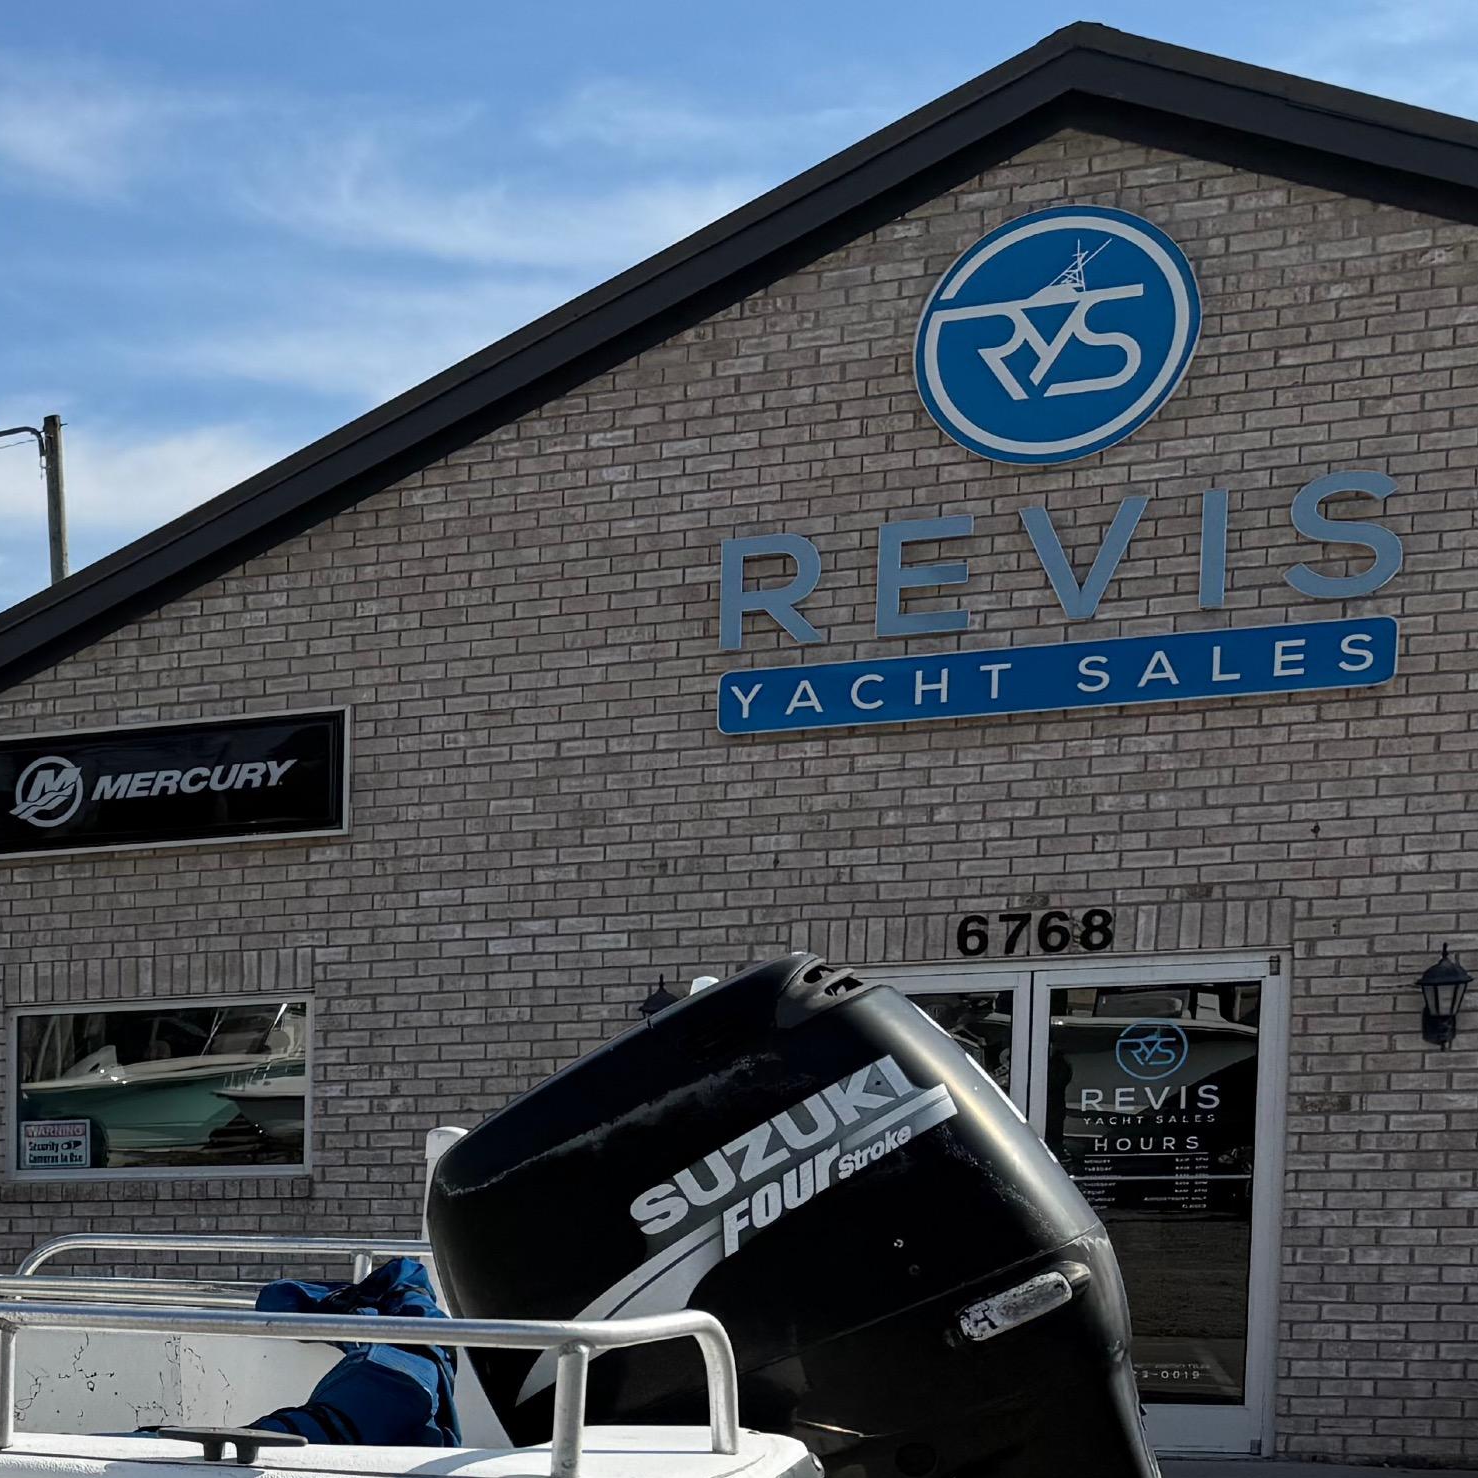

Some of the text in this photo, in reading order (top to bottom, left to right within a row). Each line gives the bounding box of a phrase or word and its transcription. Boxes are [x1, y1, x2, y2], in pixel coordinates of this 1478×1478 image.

[717, 470, 1404, 651] REVIS
[730, 633, 1376, 719] YACHT SALES
[91, 759, 298, 801] MERCURY
[956, 909, 1114, 956] 6768
[1081, 1084, 1220, 1112] REVIS
[26, 1125, 84, 1137] WARNING
[1083, 1114, 1216, 1125] YACHT SALES
[28, 1141, 59, 1153] Security
[630, 1054, 914, 1235] SUZUKI
[1094, 1136, 1199, 1151] HOURS
